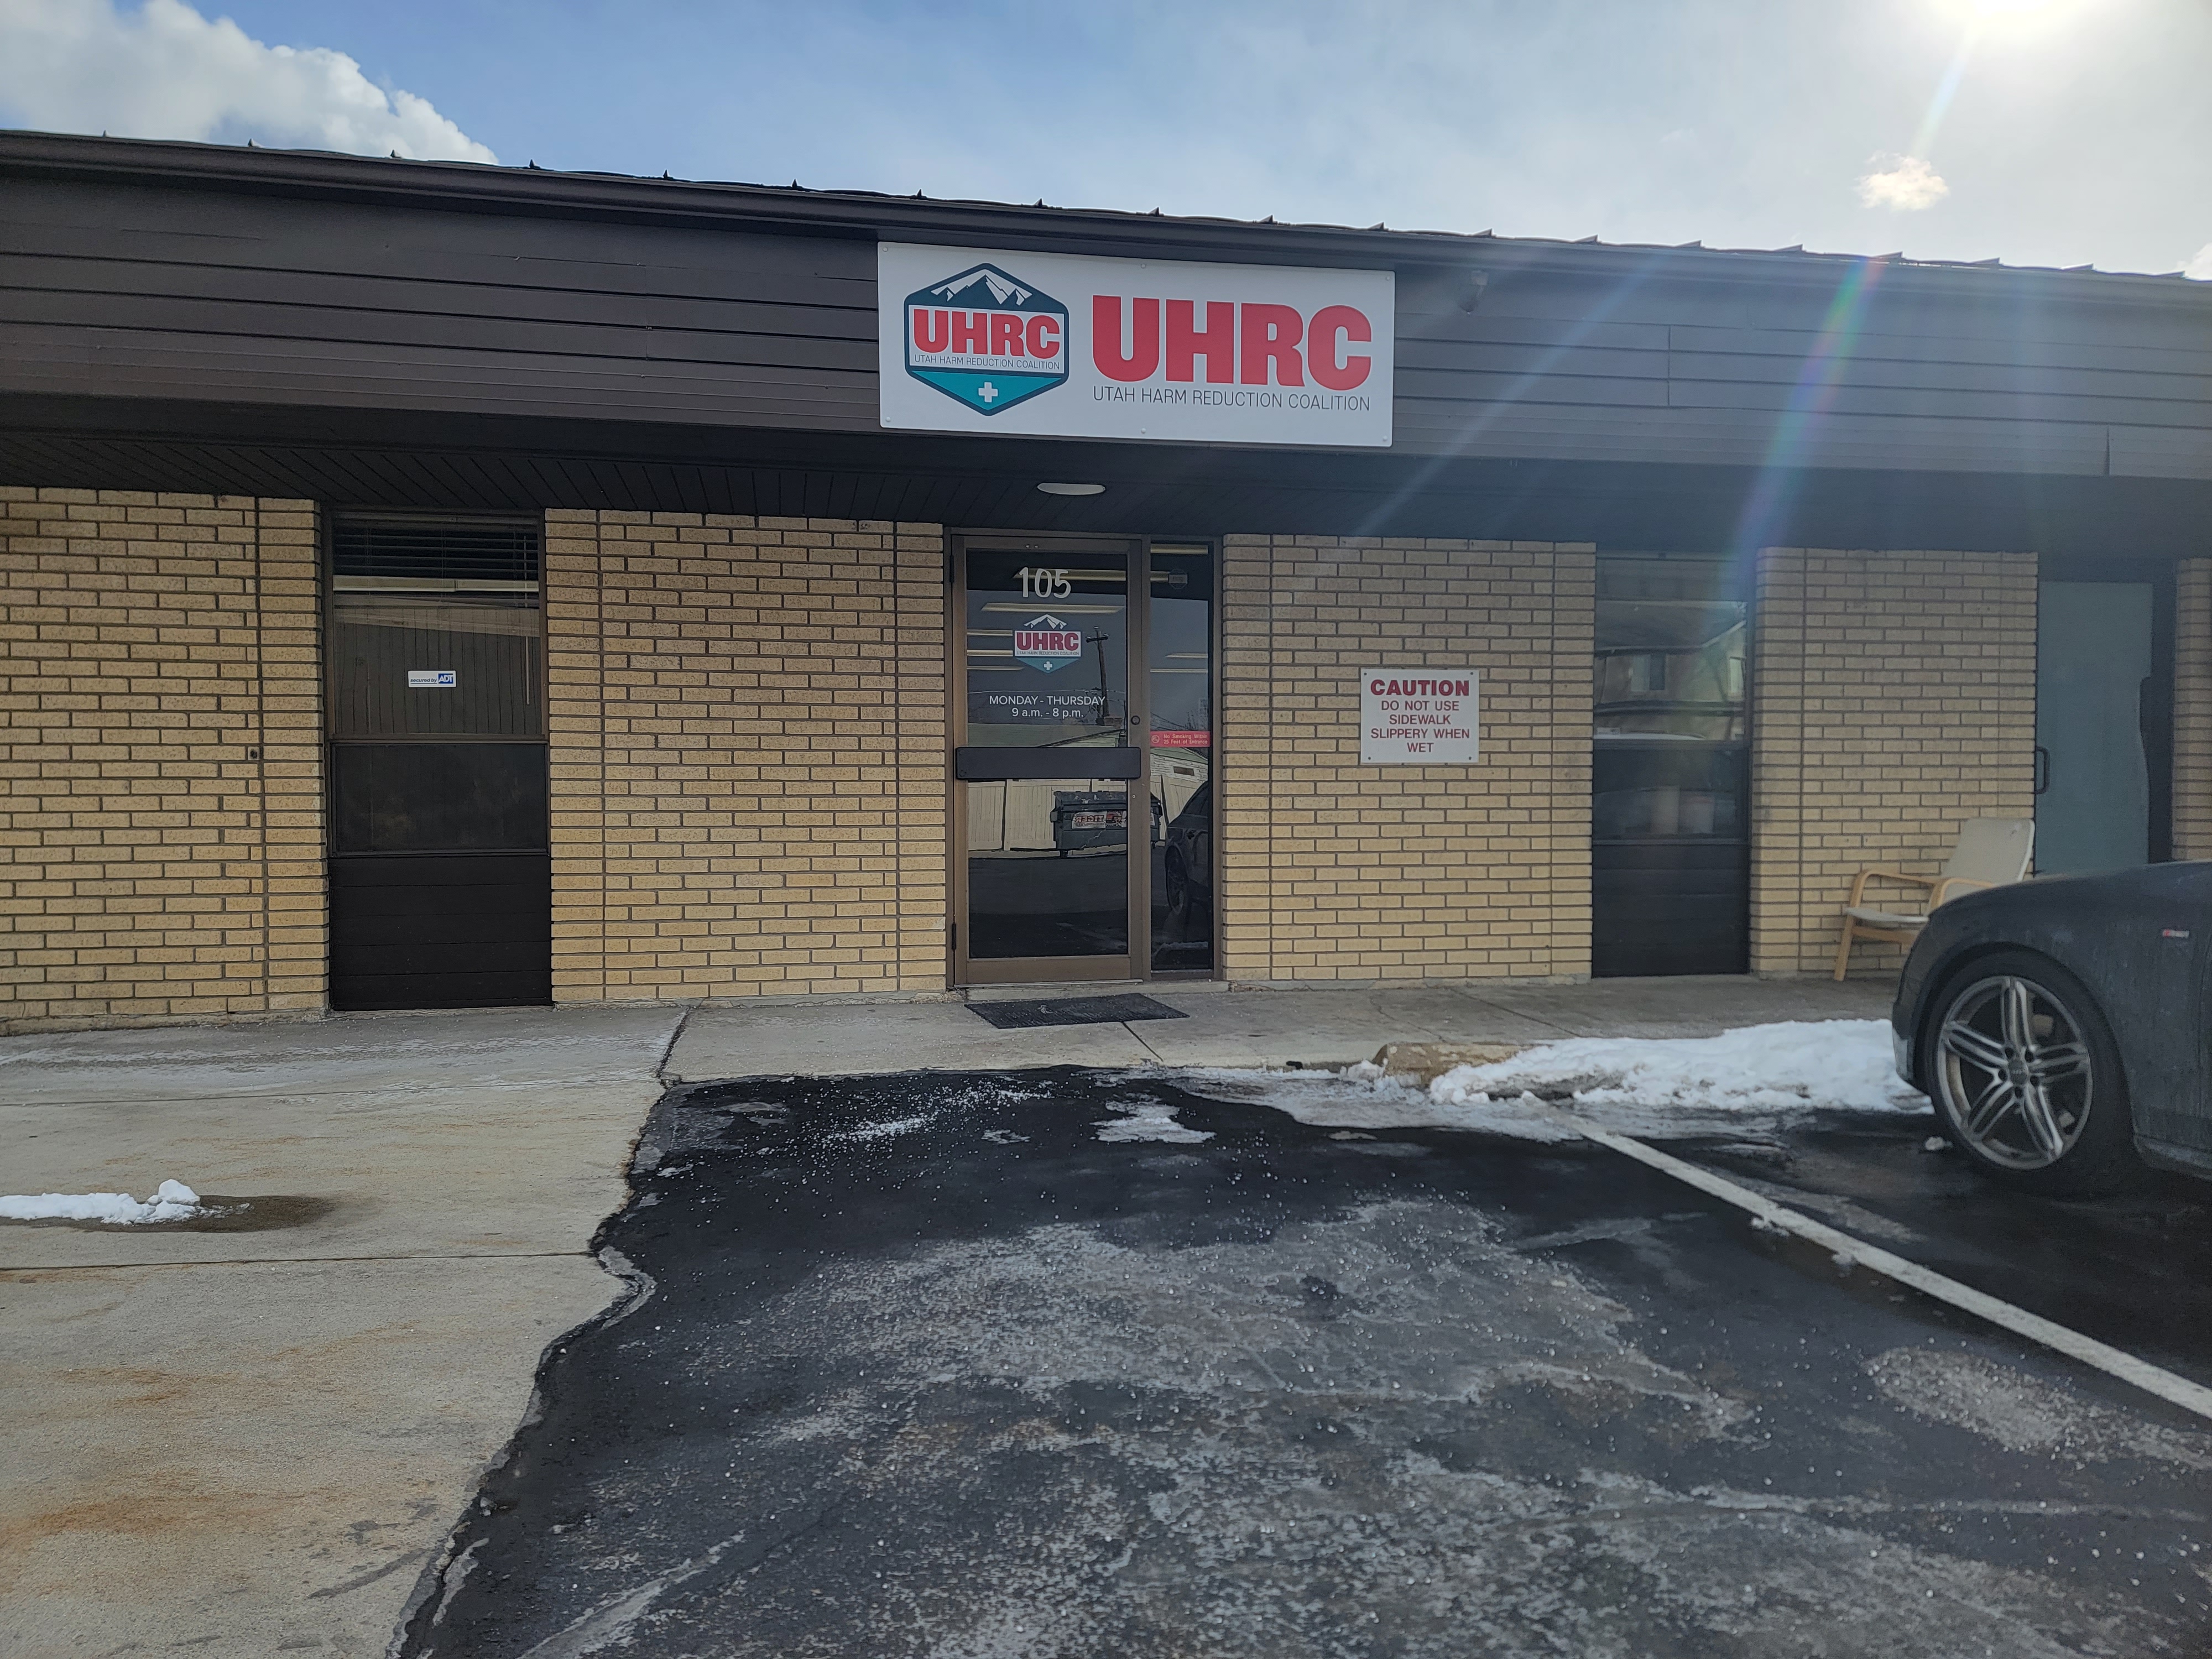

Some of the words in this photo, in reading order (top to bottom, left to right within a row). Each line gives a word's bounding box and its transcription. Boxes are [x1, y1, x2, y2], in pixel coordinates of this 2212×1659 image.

[914, 309, 1060, 359] UHRC
[1093, 295, 1372, 390] UHRC
[915, 354, 937, 363] UTAH
[940, 356, 963, 365] HARM
[966, 357, 1014, 368] REDUCTION
[1016, 359, 1060, 369] COALITION
[1093, 385, 1135, 402] UTAH
[1141, 388, 1187, 404] HARM
[1192, 390, 1282, 408] REDUCTION
[1288, 393, 1370, 411] COALITION
[1019, 567, 1071, 598] 105
[1016, 632, 1079, 651] UHRC
[439, 675, 453, 683] ADT
[1370, 679, 1469, 696] CAUTION
[989, 695, 1039, 705] MONDAY
[1046, 696, 1105, 706] THURSDAY
[1381, 700, 1400, 711] DO
[1405, 700, 1430, 711] NOT
[1435, 701, 1459, 711] USE
[1011, 708, 1019, 717] 9
[1052, 708, 1059, 717] 8
[1062, 709, 1083, 719] p.m.
[1389, 714, 1451, 725] SIDEWALK
[1371, 728, 1428, 739] SLIPPERY
[1433, 728, 1470, 739] WHEN
[1407, 743, 1434, 753] WET
